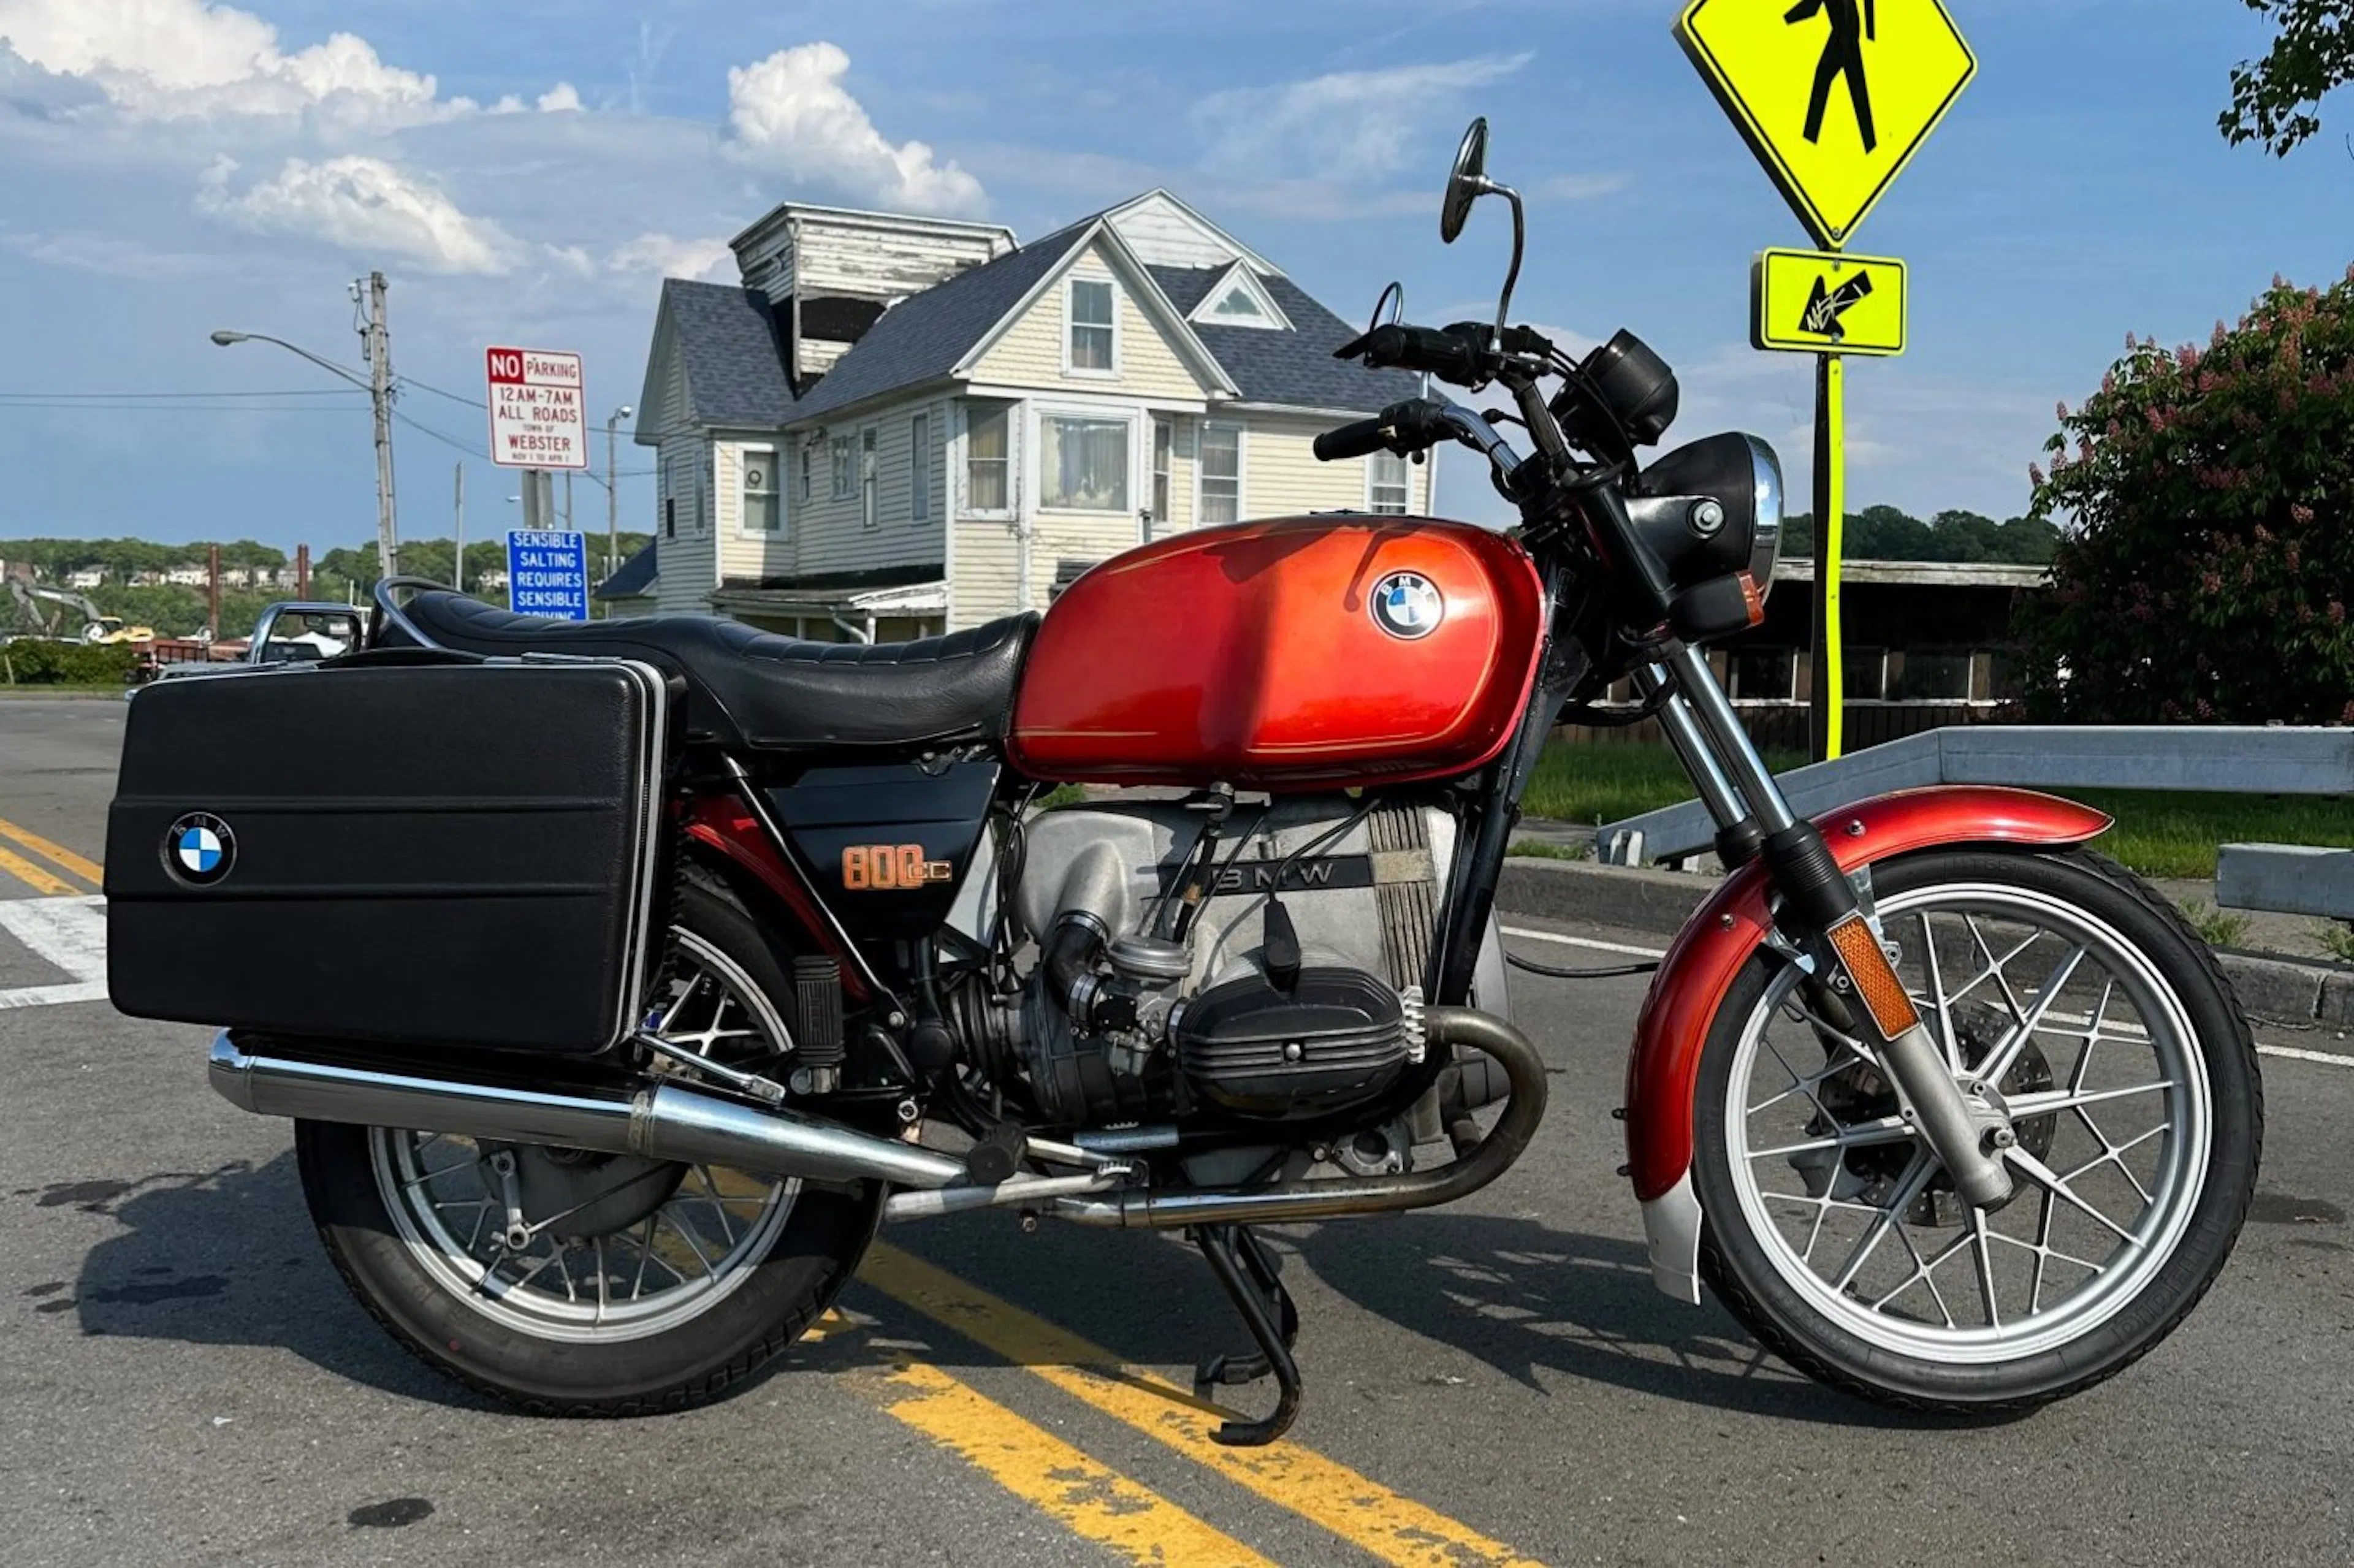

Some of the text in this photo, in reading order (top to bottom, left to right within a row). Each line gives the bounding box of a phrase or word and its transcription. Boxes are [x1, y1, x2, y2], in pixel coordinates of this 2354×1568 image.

[491, 354, 577, 379] NO PARKING
[499, 405, 577, 423] ALL ROADS
[508, 434, 571, 451] WEBSTER
[514, 532, 578, 549] SENSIBLE
[520, 552, 577, 568] SALTING
[517, 571, 582, 588] REQUIRES
[517, 590, 582, 607] SENSIBLE
[174, 815, 229, 840] BMW
